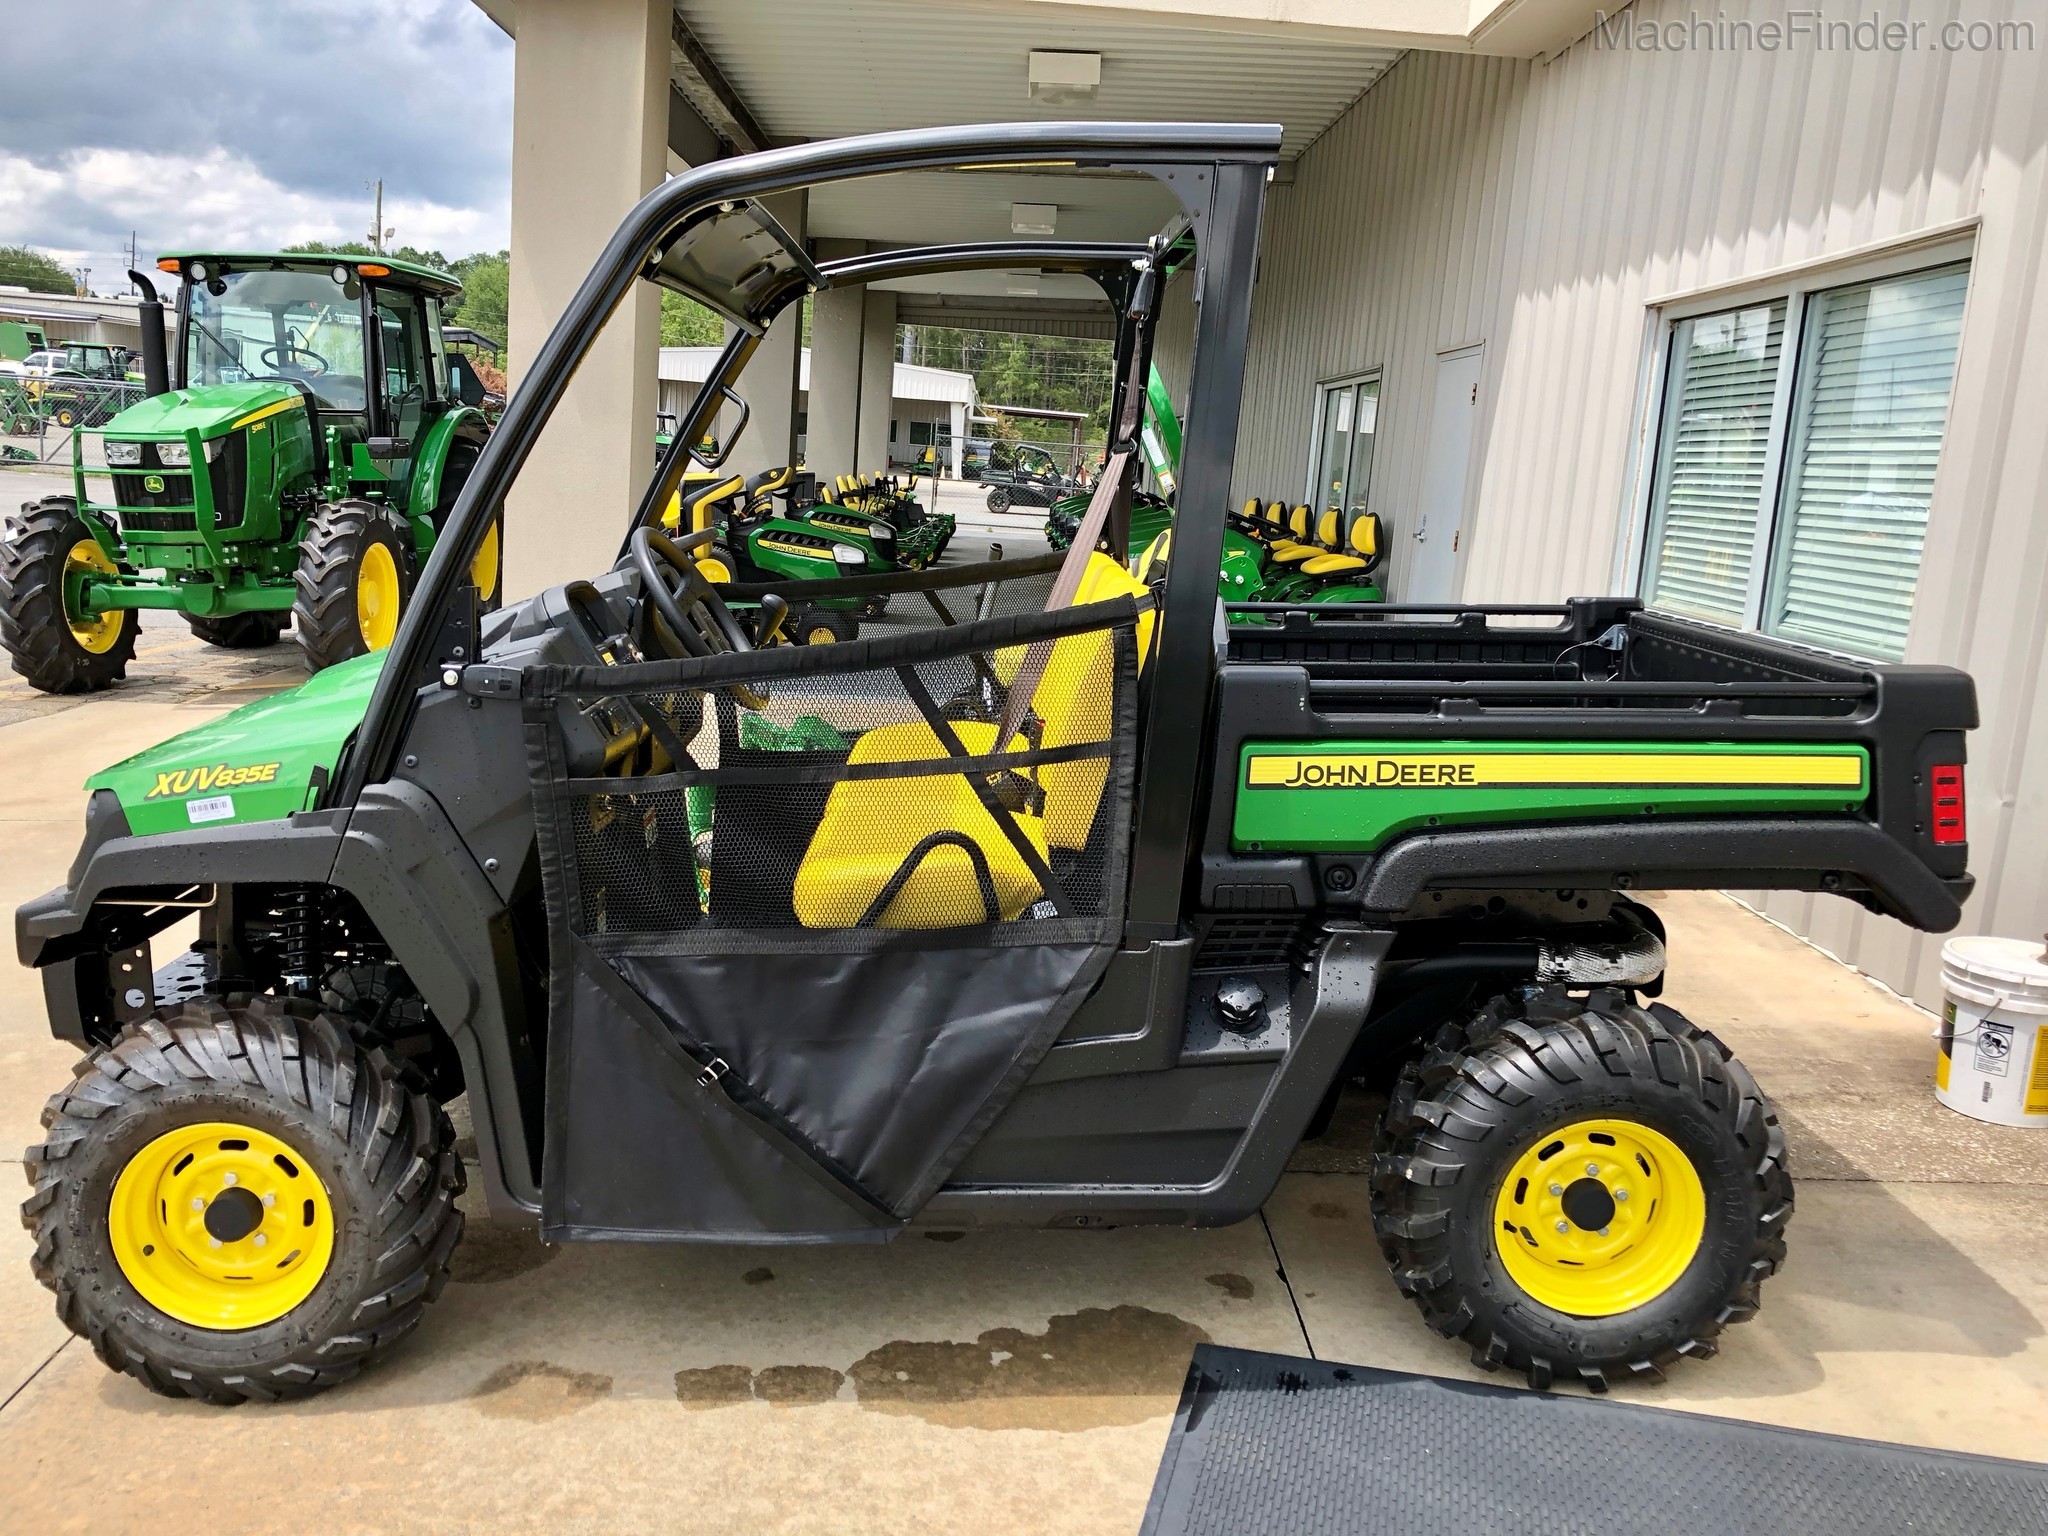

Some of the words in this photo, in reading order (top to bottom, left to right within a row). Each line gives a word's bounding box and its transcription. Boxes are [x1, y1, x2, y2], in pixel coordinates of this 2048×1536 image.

[819, 522, 833, 530] JOHN
[833, 524, 852, 533] DEERE
[767, 542, 787, 552] JOHN
[787, 545, 811, 555] DEERE
[145, 763, 281, 798] XUV835E
[1285, 761, 1367, 784] JOHN
[1376, 760, 1475, 783] DEERE
